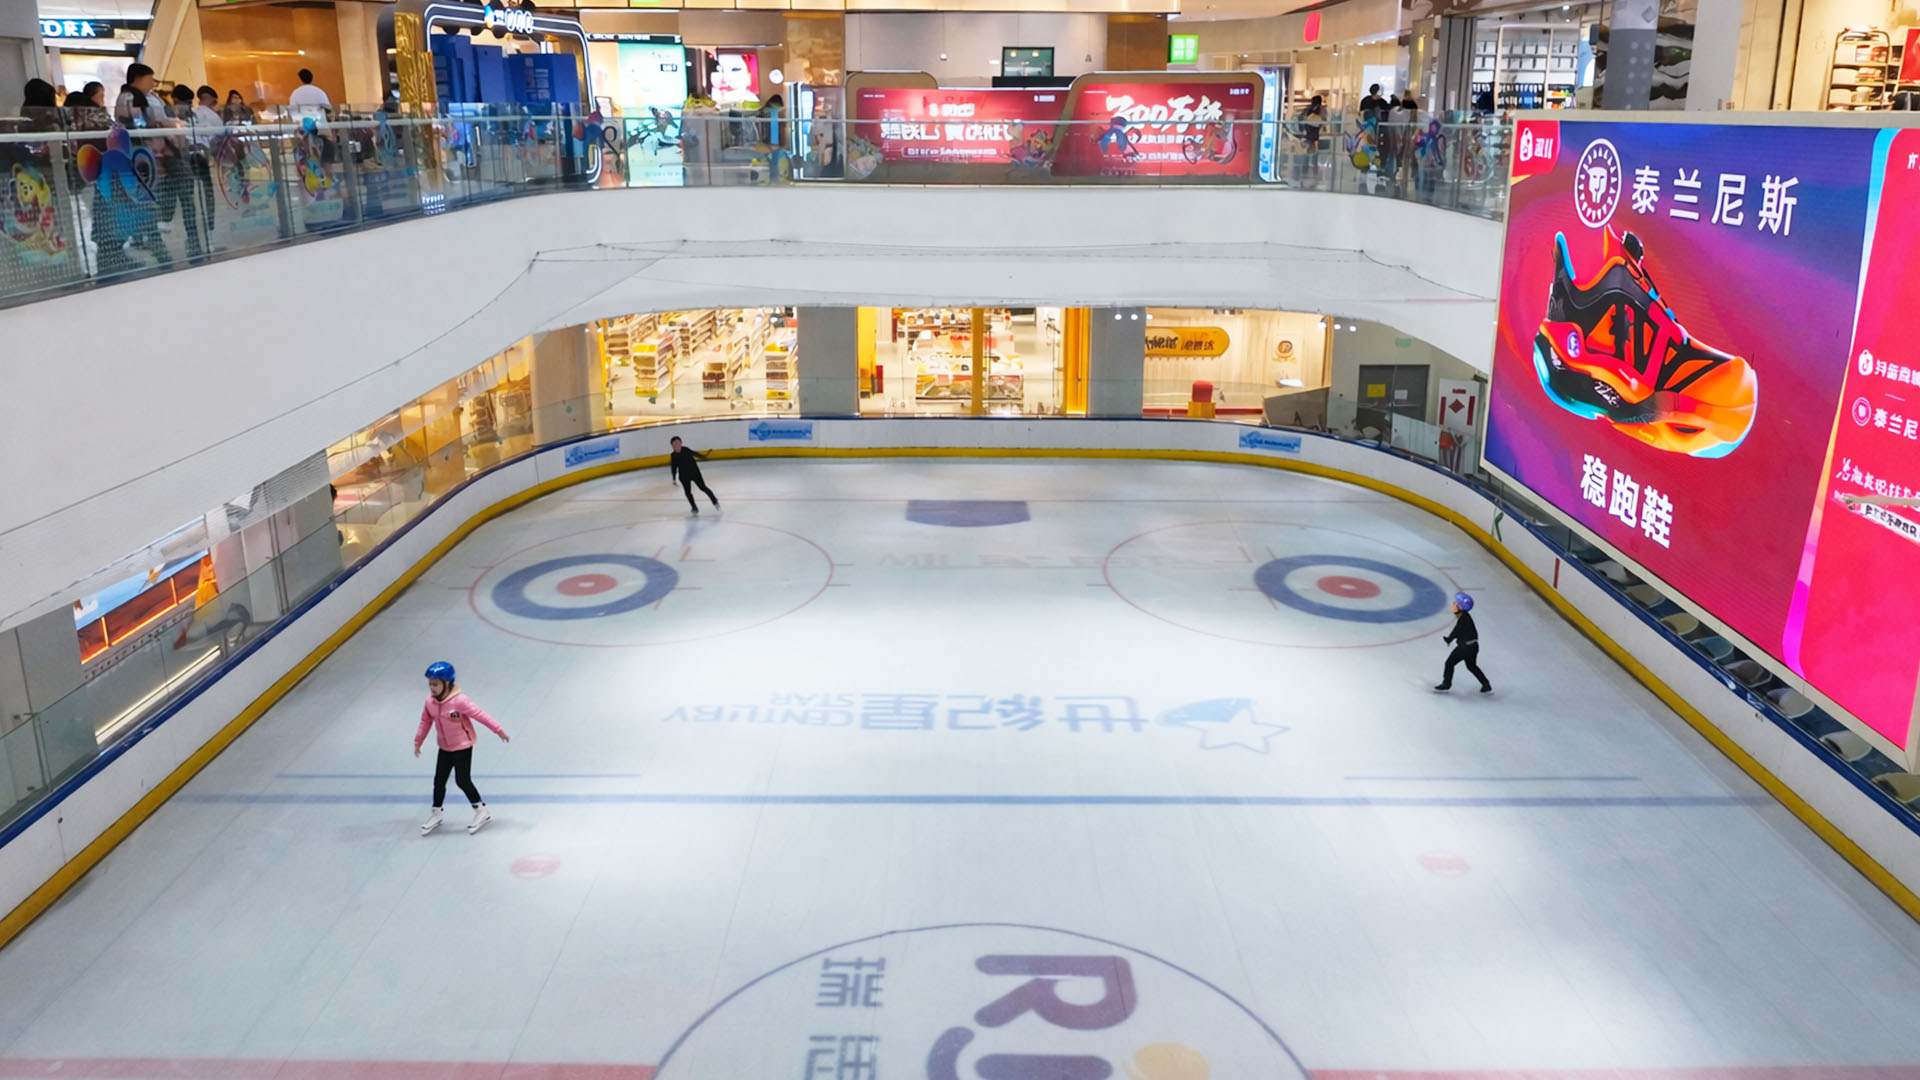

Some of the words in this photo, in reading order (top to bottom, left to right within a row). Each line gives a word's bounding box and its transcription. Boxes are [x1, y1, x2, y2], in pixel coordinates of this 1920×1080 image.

[1631, 165, 1800, 236] 泰兰尼斯
[1580, 454, 1675, 550] 稳跑鞋
[770, 693, 855, 707] STAR
